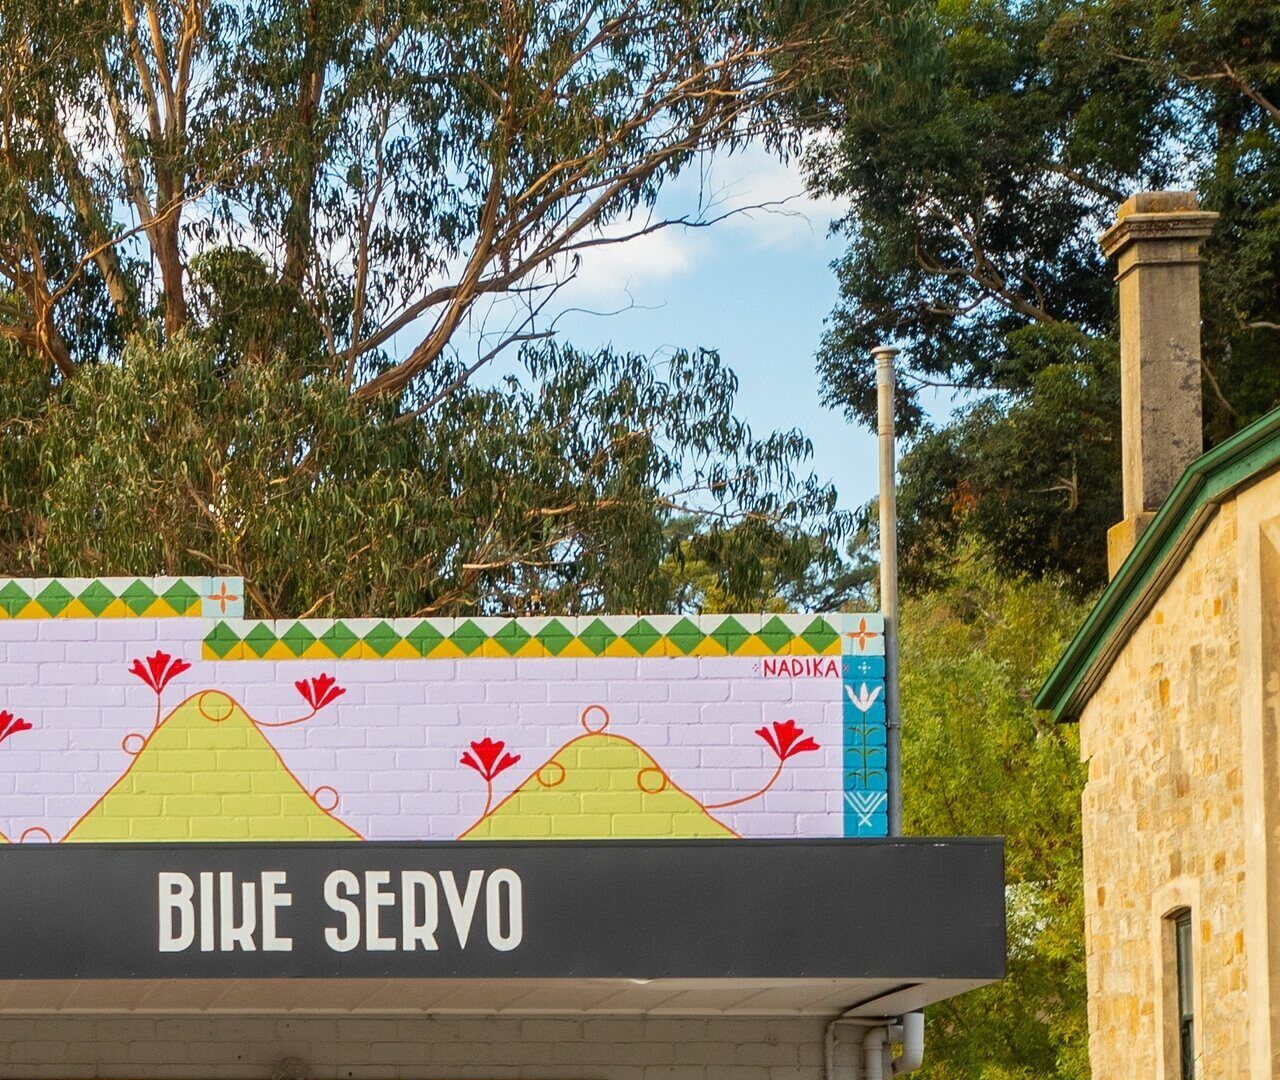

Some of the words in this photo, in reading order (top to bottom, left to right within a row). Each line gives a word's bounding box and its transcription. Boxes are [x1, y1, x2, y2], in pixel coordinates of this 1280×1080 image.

[763, 658, 839, 678] NADIKA
[158, 872, 293, 952] BIKE
[324, 868, 523, 952] SERVO
